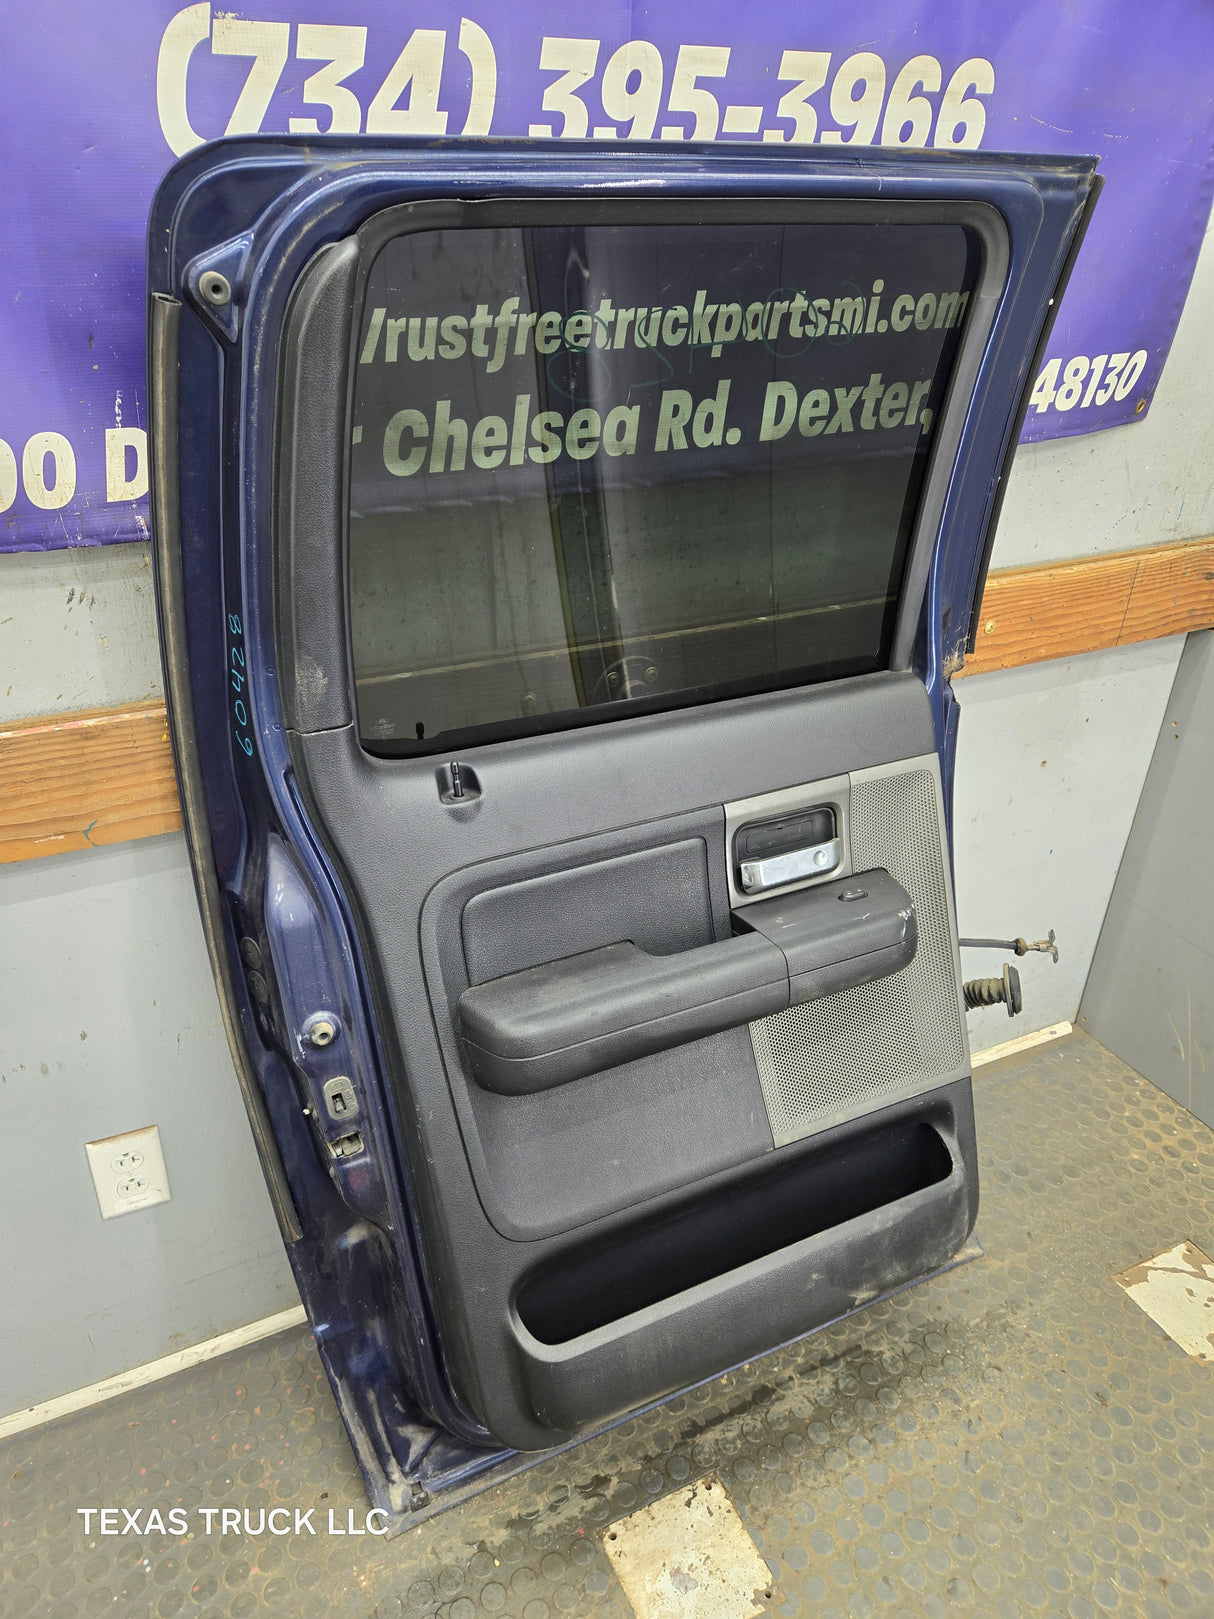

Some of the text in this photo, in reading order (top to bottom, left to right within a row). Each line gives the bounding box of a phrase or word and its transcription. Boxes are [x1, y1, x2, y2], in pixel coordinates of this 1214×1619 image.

[157, 2, 996, 158] (734) 395-3966
[382, 394, 641, 477] Chelsea
[654, 379, 742, 452] Rd.
[759, 373, 934, 442] Dexter,
[1029, 349, 1148, 414] 48130
